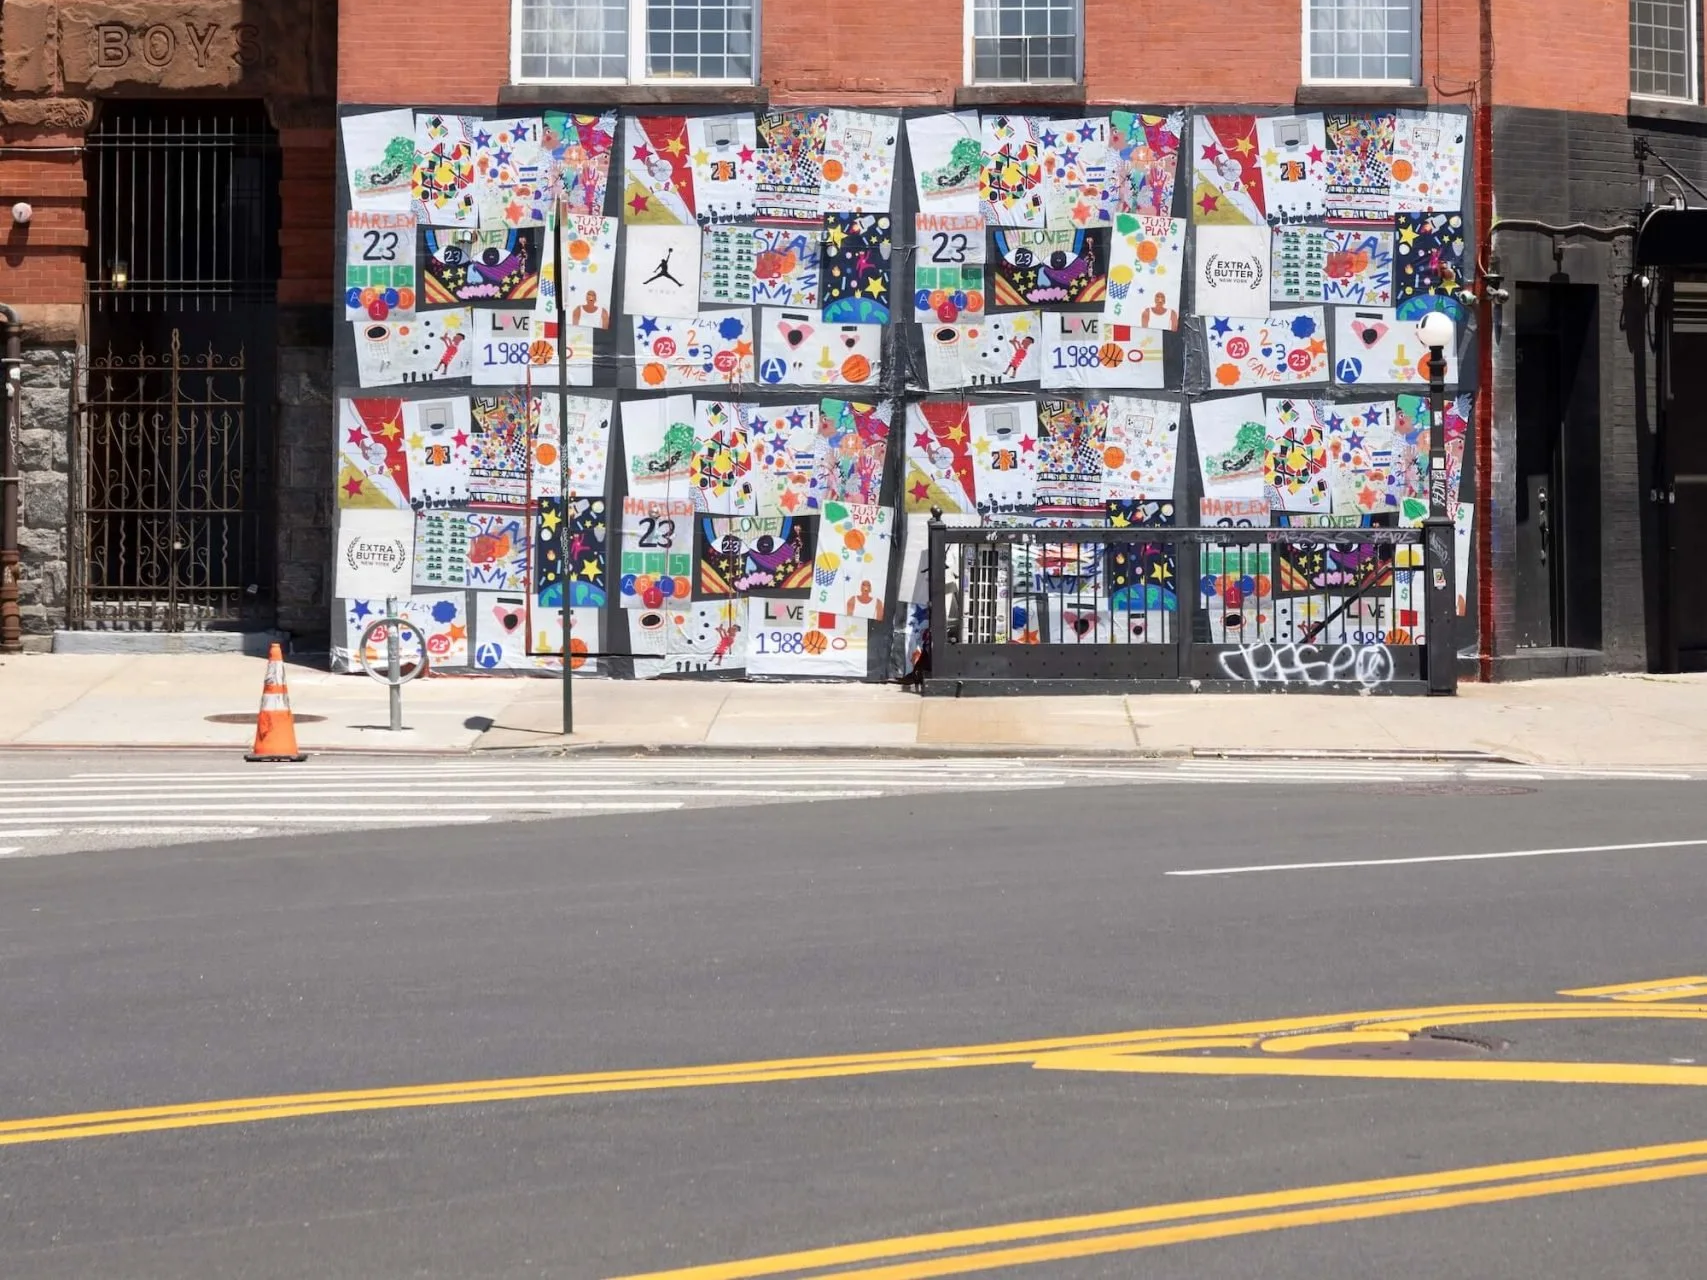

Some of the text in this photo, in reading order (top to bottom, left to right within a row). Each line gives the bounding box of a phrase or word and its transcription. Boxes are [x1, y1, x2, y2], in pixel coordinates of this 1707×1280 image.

[347, 211, 417, 229] HARLEM
[575, 216, 606, 227] JUST
[916, 213, 985, 231] HARLEM
[1142, 216, 1174, 227] JUST
[577, 225, 601, 236] PLAY
[1021, 230, 1069, 245] LOVE
[1145, 226, 1170, 236] PLAY
[363, 230, 399, 261] 23
[932, 232, 968, 263] 23
[445, 250, 461, 262] 23
[1016, 253, 1032, 265] 23
[1214, 269, 1253, 278] BUTTER
[1217, 261, 1251, 270] EXTRA
[484, 342, 530, 366] 1988
[1053, 345, 1101, 369] 1988
[765, 358, 784, 379] A
[1247, 357, 1282, 382] GAME
[1340, 357, 1360, 379] A
[850, 504, 881, 516] JUST
[1201, 498, 1269, 516] HARLEM
[853, 514, 877, 525] PLAY
[638, 517, 675, 548] 23
[360, 543, 393, 553] EXTRA
[722, 540, 740, 552] 23
[356, 552, 395, 562] BUTTER
[675, 555, 684, 575] 5
[756, 631, 804, 655] 1988
[480, 643, 499, 663] A
